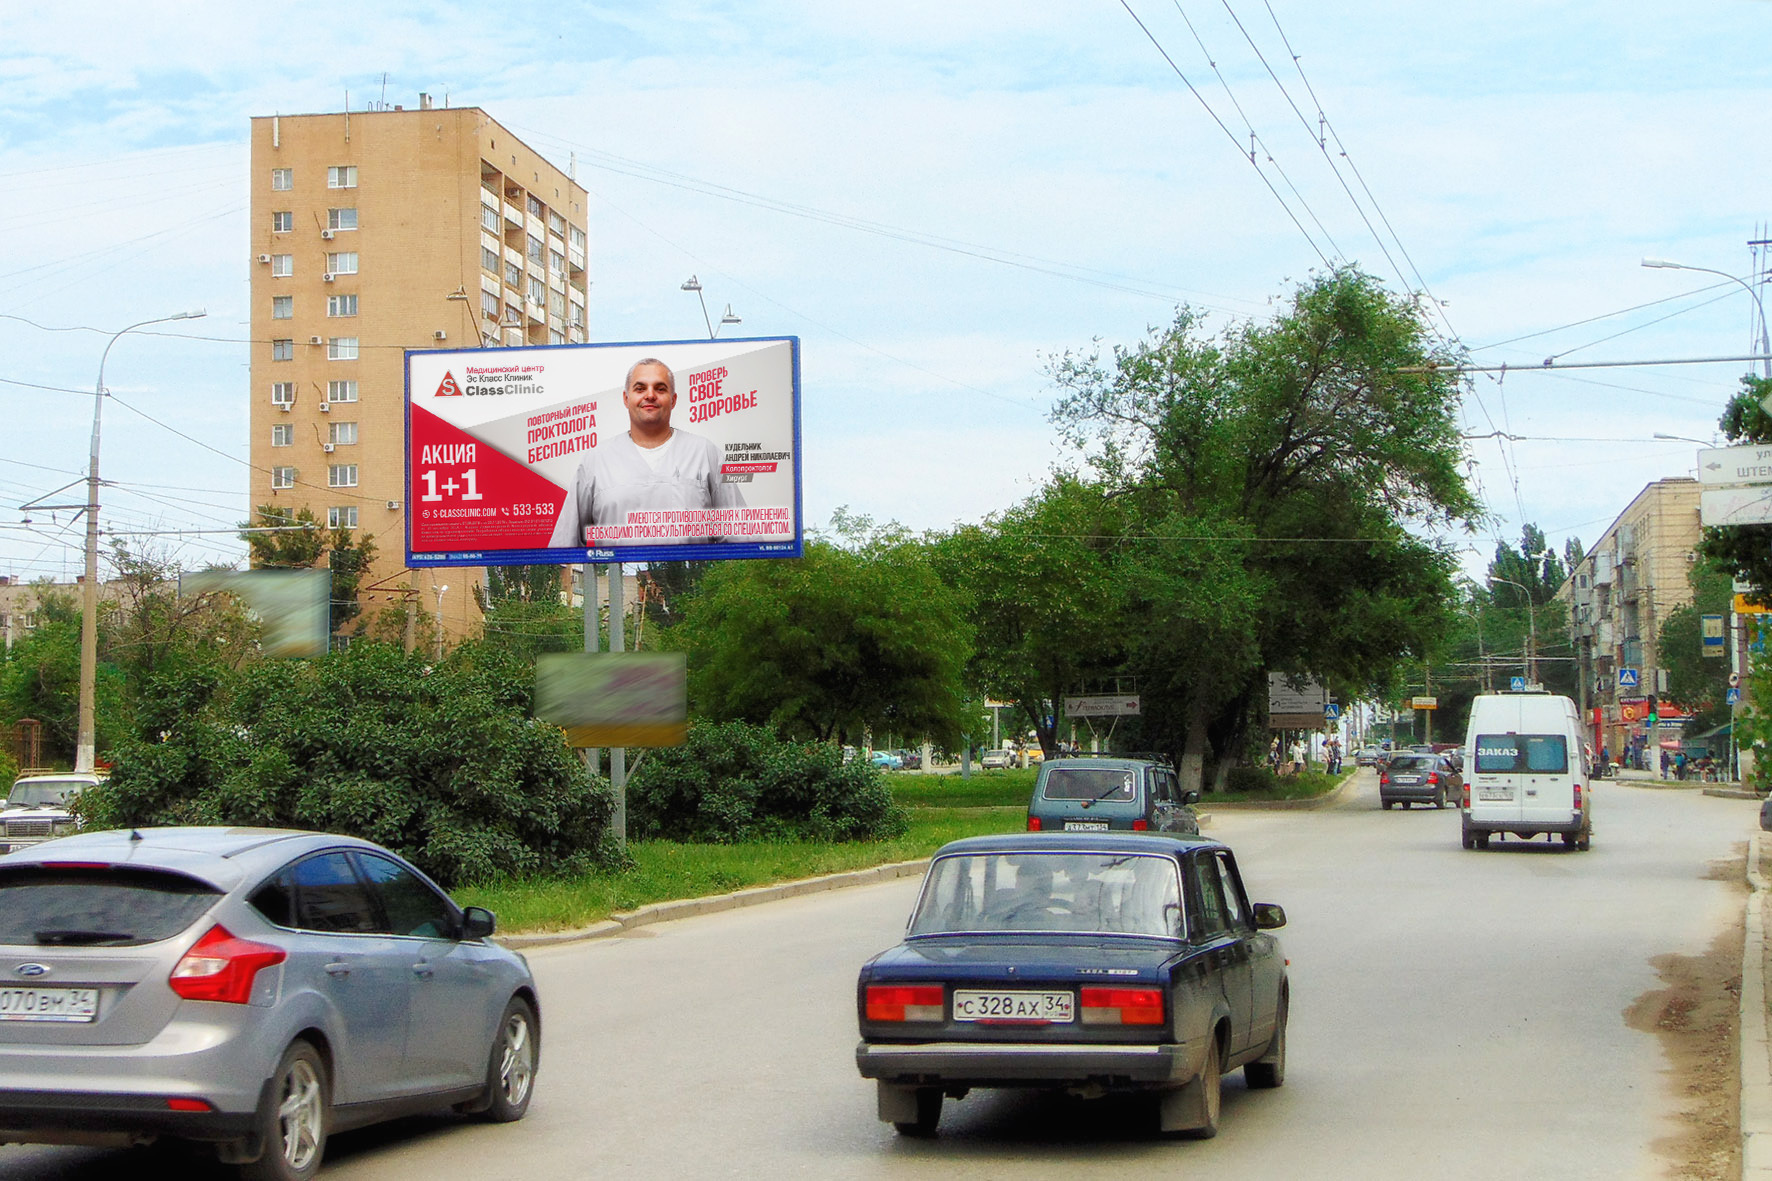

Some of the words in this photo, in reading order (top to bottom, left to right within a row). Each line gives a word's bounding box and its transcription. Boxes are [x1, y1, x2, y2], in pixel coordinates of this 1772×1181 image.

[466, 366, 519, 374] Медицинский
[521, 365, 544, 373] центр
[466, 375, 477, 383] Эс
[479, 374, 502, 382] Класс
[504, 373, 533, 382] Клиник
[689, 366, 728, 386] ПРОВЕРЬ
[466, 384, 544, 396] ClassClinic
[689, 379, 723, 403] СВОЕ
[527, 406, 571, 427] ПОВТОРНЫЙ
[572, 401, 597, 416] ПРИЕМ
[689, 389, 758, 423] ЗДОРОВЬЕ
[527, 414, 596, 444] ПРОКТОЛОГА
[421, 443, 476, 466] АКЦИЯ
[528, 432, 597, 464] БЕСПЛАТНО
[725, 443, 761, 452] КУДЕЛЬНИК
[725, 451, 750, 462] АНДРЕЙ
[750, 452, 791, 461] НИКОЛАЕВИЧ
[421, 468, 483, 502] 1+1
[513, 503, 554, 516] 533-533
[627, 512, 661, 524] ИМЕЮТСЯ
[663, 509, 734, 523] ПРОТИВОПОКАЗАНИЯ
[741, 507, 791, 521] ПРИМЕНЕНИЮ.
[586, 525, 633, 539] НЕОБХОДИМО
[634, 523, 722, 538] ПРОКОНСУЛЬТИРОВАТЬСЯ
[723, 523, 732, 535] СО
[733, 521, 791, 536] СПЕЦИАЛИСТОМ.
[1478, 748, 1518, 756] ЗАКАЗ
[1045, 996, 1064, 1011] 34
